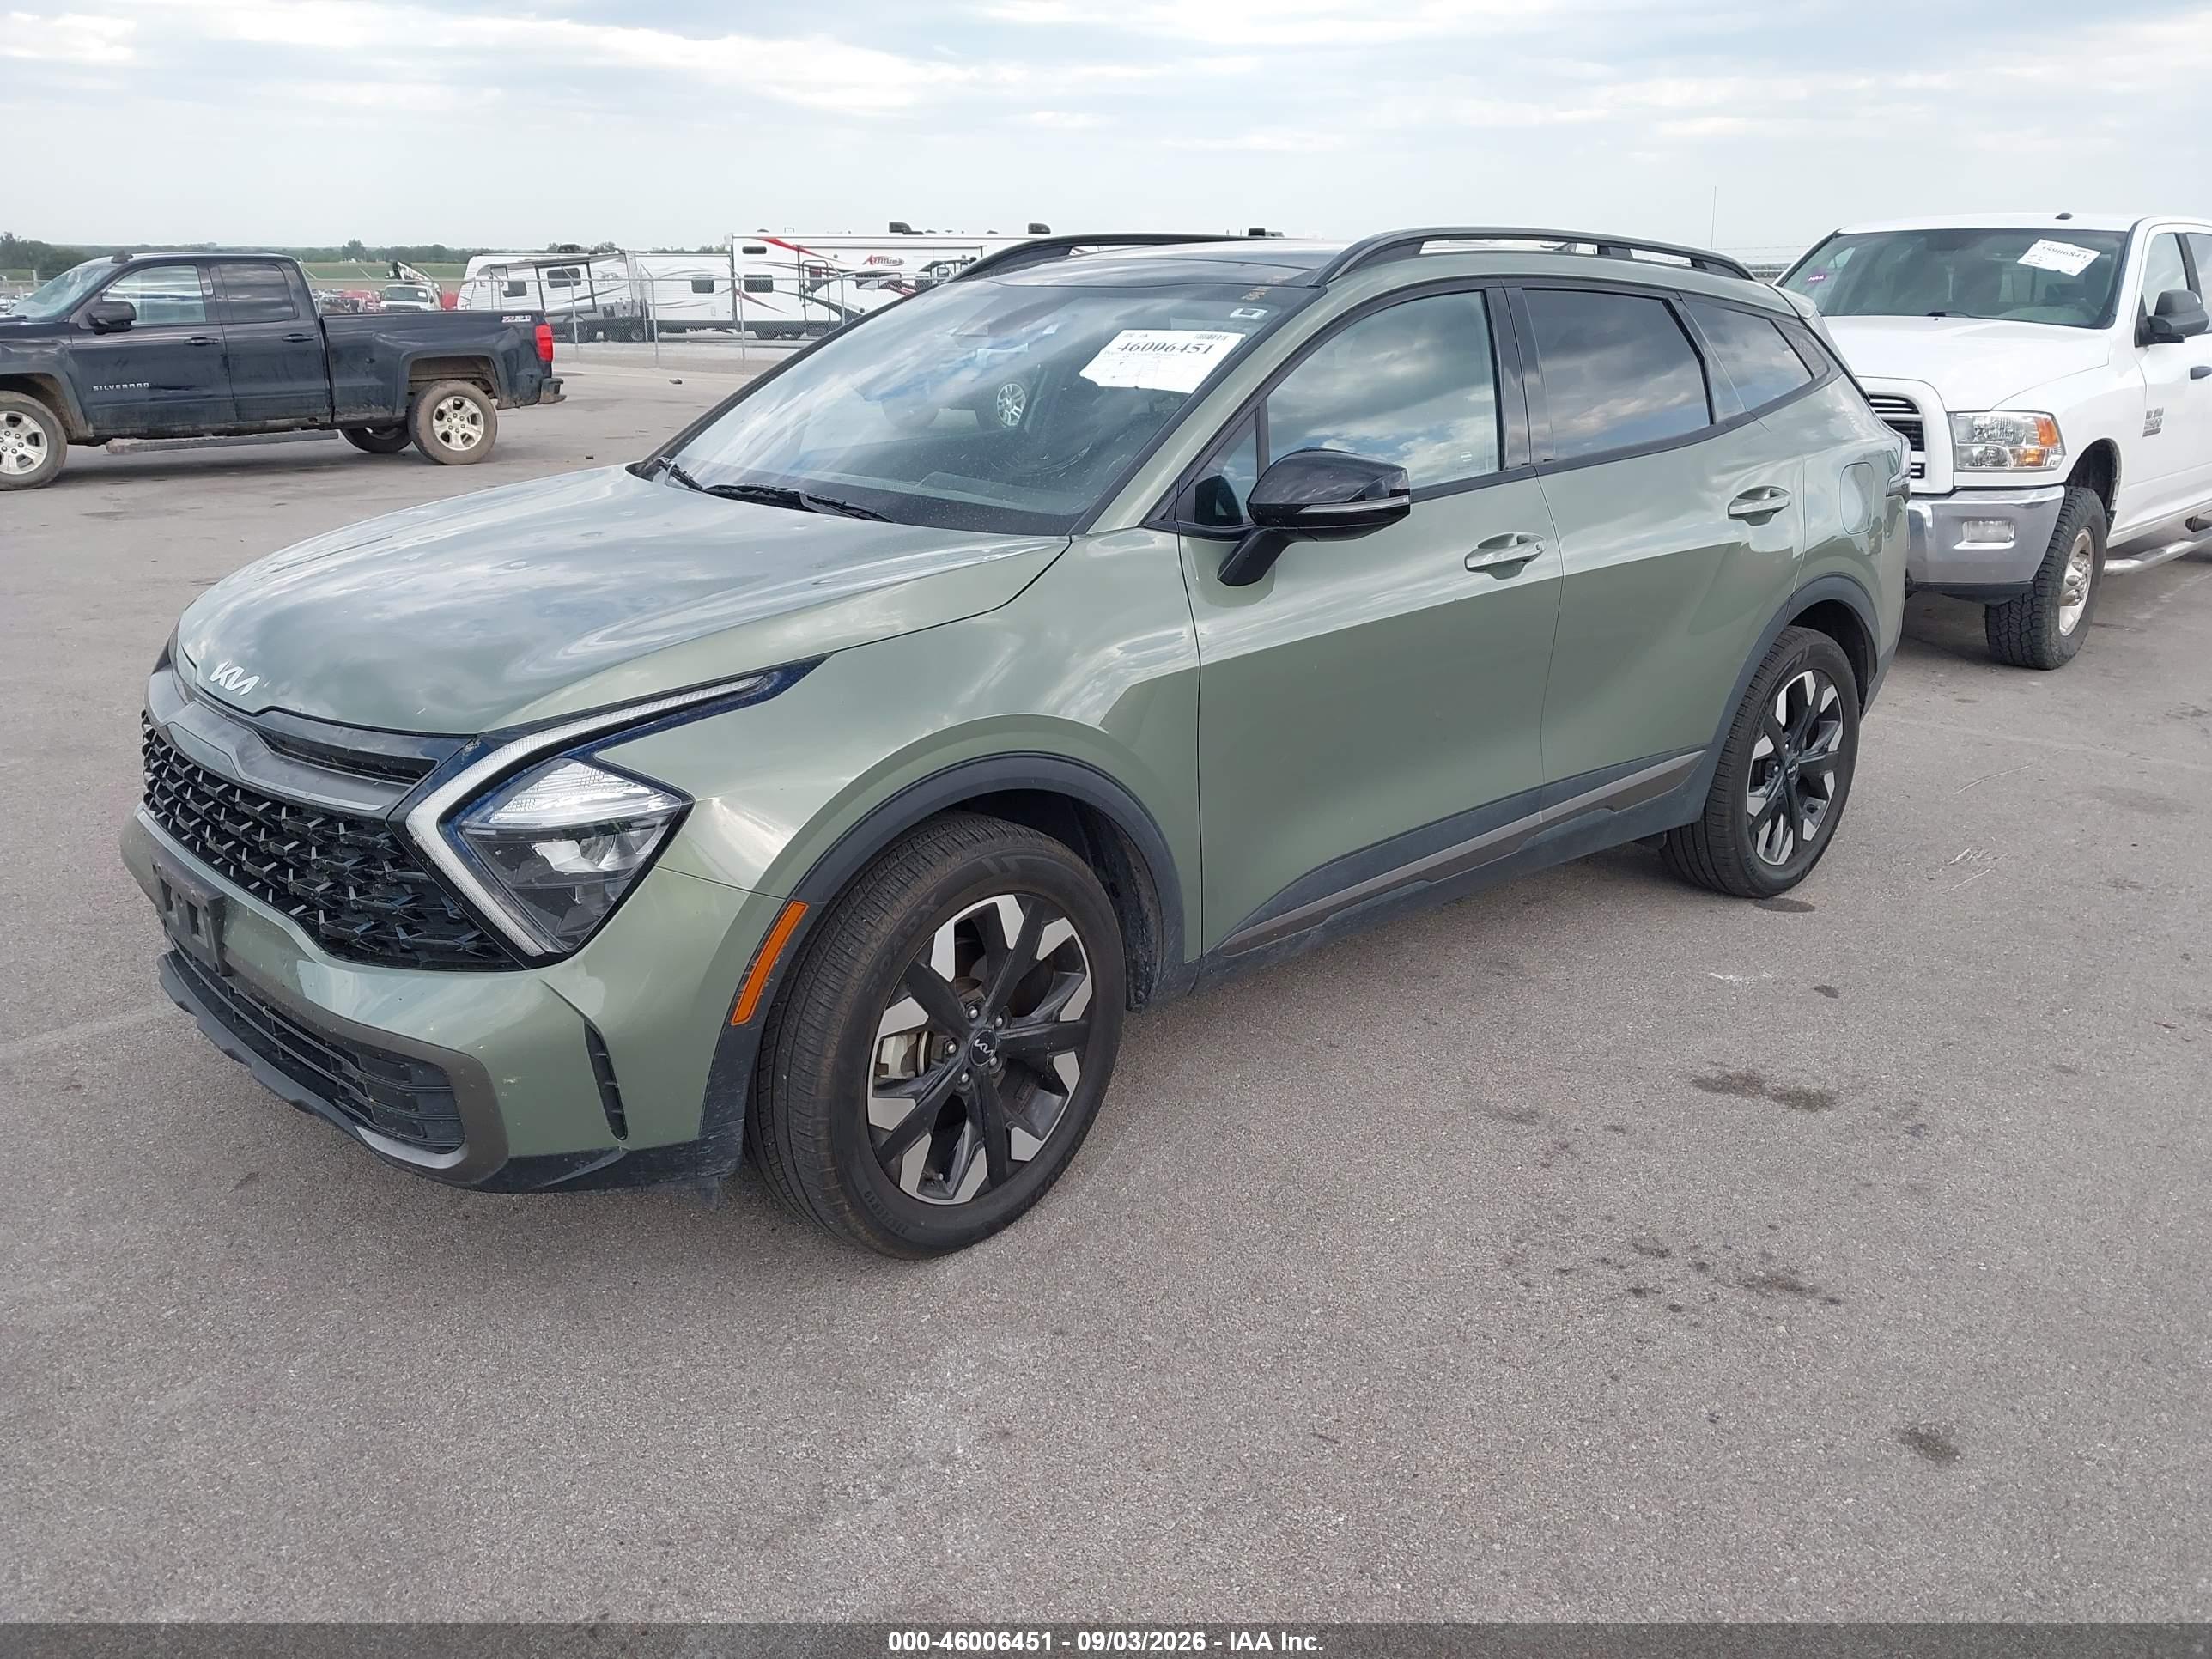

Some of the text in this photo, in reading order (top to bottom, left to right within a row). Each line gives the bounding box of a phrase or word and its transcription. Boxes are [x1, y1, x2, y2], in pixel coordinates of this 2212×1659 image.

[1117, 342, 1214, 354] 46006451
[92, 382, 149, 392] SILVERADO
[208, 660, 260, 696] KIA
